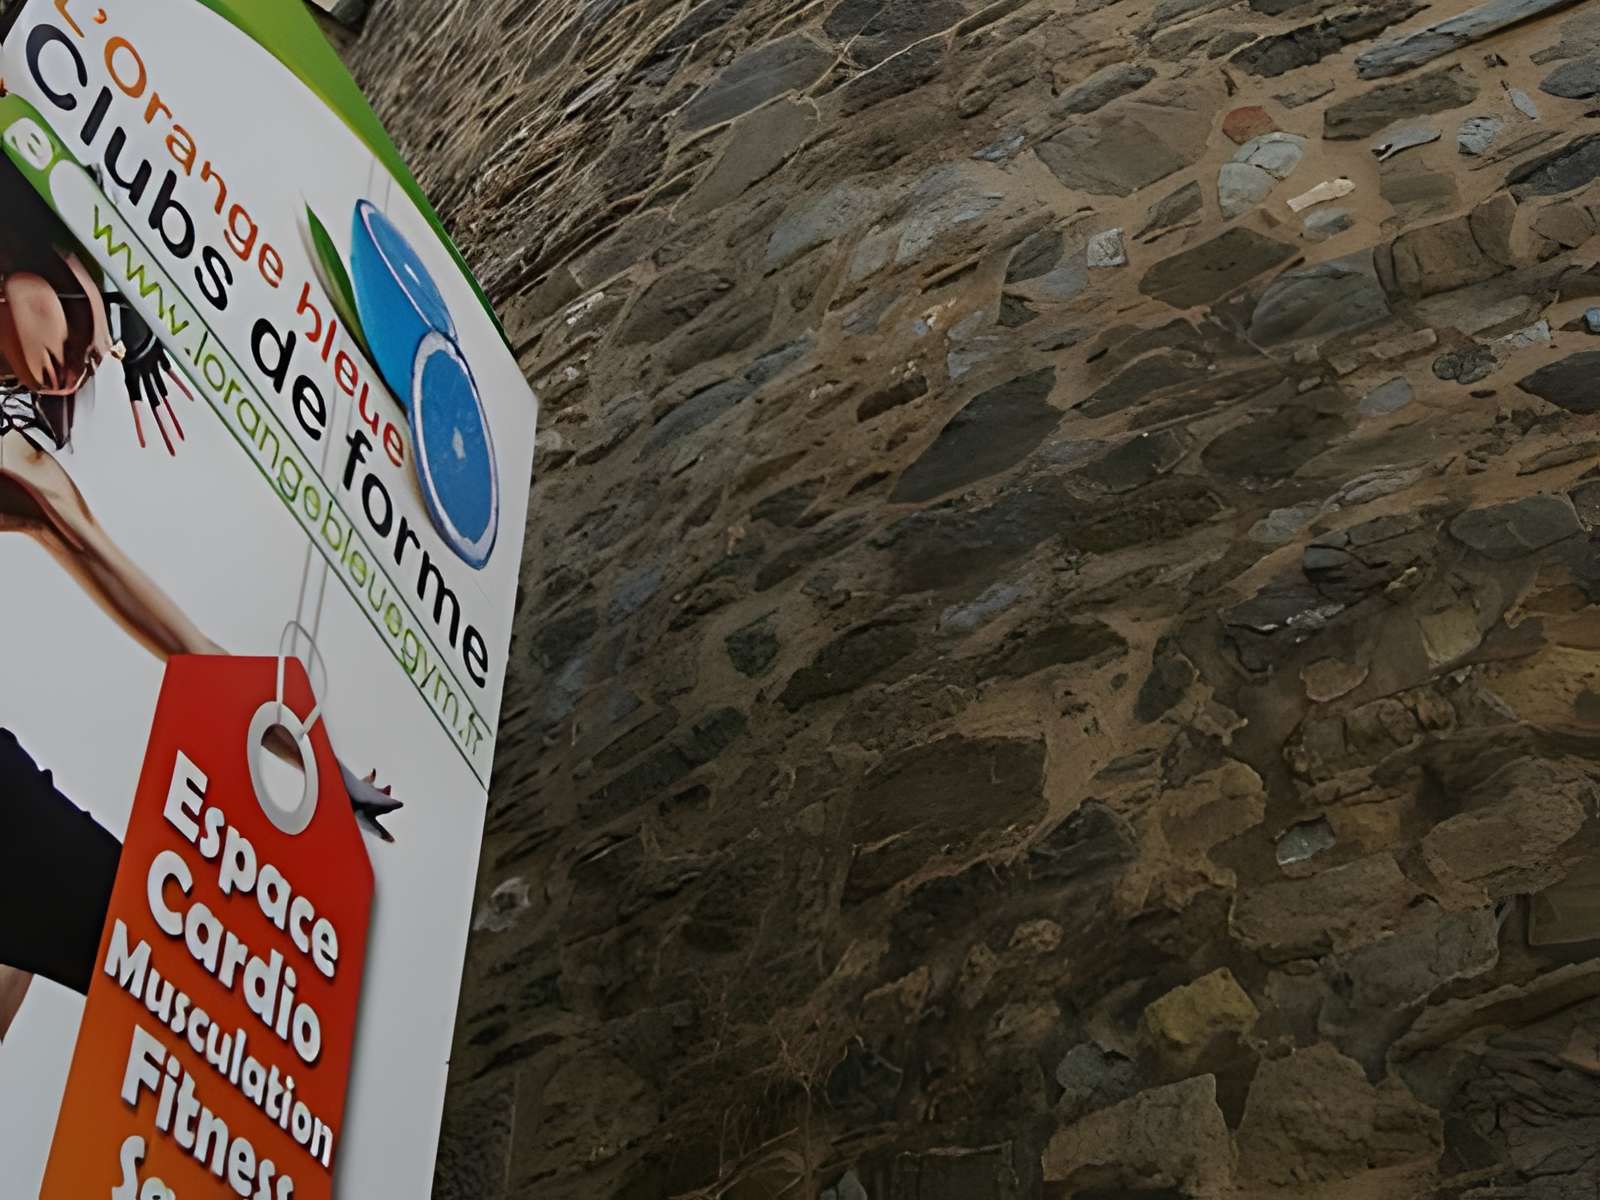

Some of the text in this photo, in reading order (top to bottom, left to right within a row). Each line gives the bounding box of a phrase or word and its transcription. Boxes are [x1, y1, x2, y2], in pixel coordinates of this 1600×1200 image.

[25, 23, 488, 689] Clubs de forme
[297, 281, 404, 468] bleue
[147, 850, 321, 1063] Cardio
[163, 749, 338, 978] Espace
[104, 919, 333, 1167] Musculation
